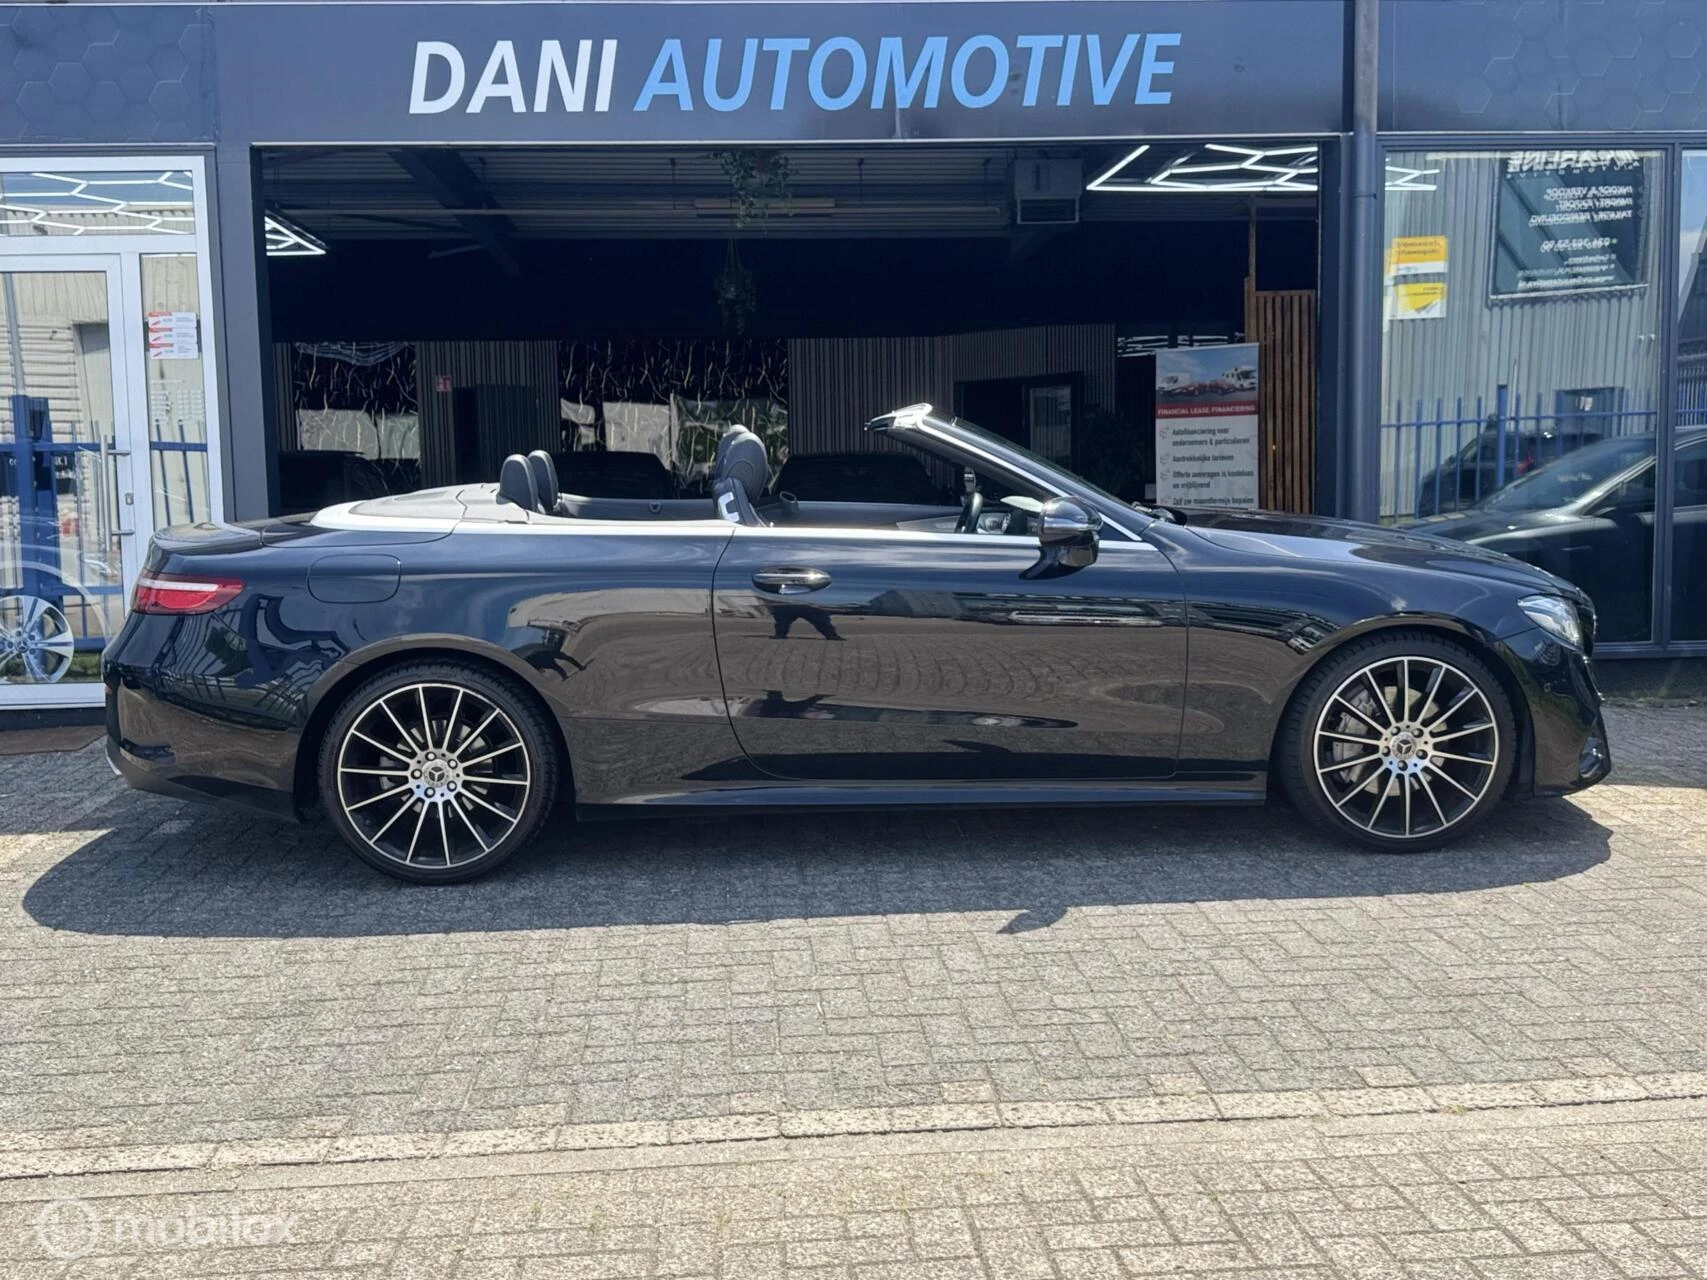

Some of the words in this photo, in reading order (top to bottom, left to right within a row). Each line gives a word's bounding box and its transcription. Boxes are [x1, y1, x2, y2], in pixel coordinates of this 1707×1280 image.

[409, 39, 618, 115] DANI
[633, 32, 1182, 112] AUTOMOTIVE
[1157, 407, 1189, 416] FINANCIAL
[1190, 406, 1209, 415] LEASE
[1211, 405, 1256, 413] FINANCIERING
